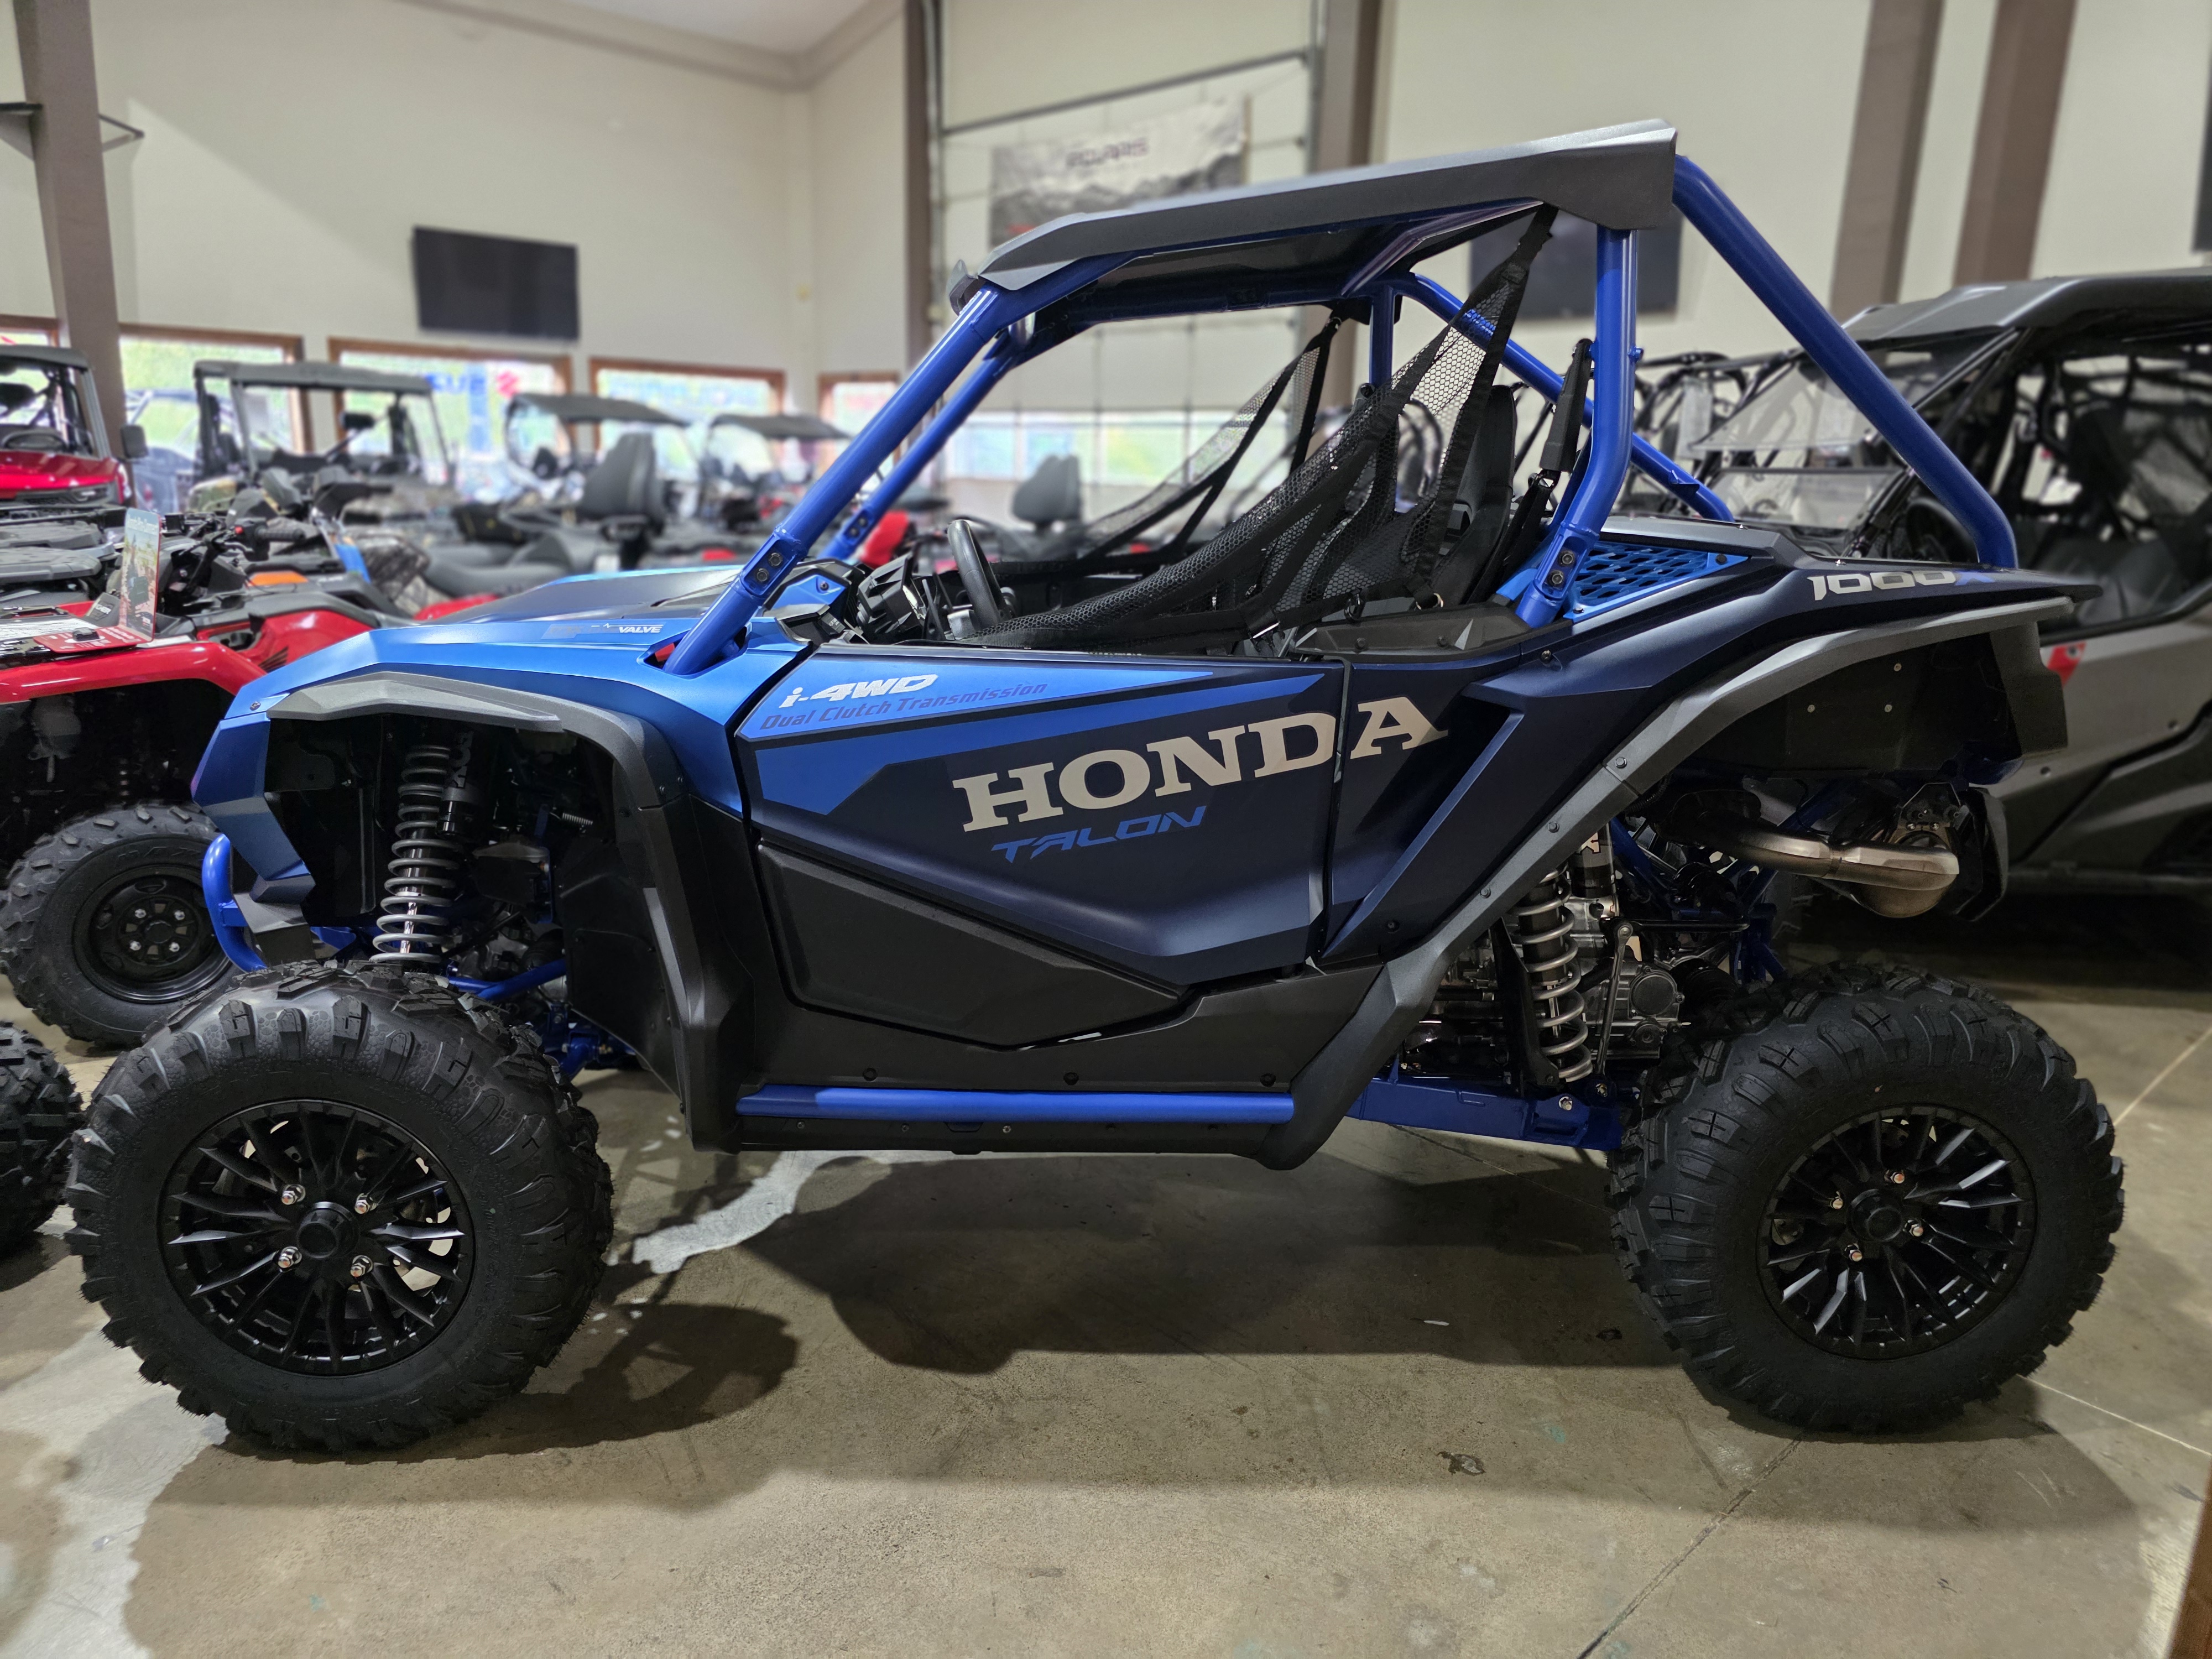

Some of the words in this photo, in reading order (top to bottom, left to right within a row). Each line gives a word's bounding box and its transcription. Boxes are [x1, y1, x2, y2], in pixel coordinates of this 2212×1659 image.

[760, 710, 816, 730] Dual
[818, 701, 892, 722] Clutch
[894, 684, 1048, 712] Transmission
[779, 674, 938, 708] i-4WD
[952, 697, 1448, 832] HONDA
[990, 805, 1206, 863] TALON
